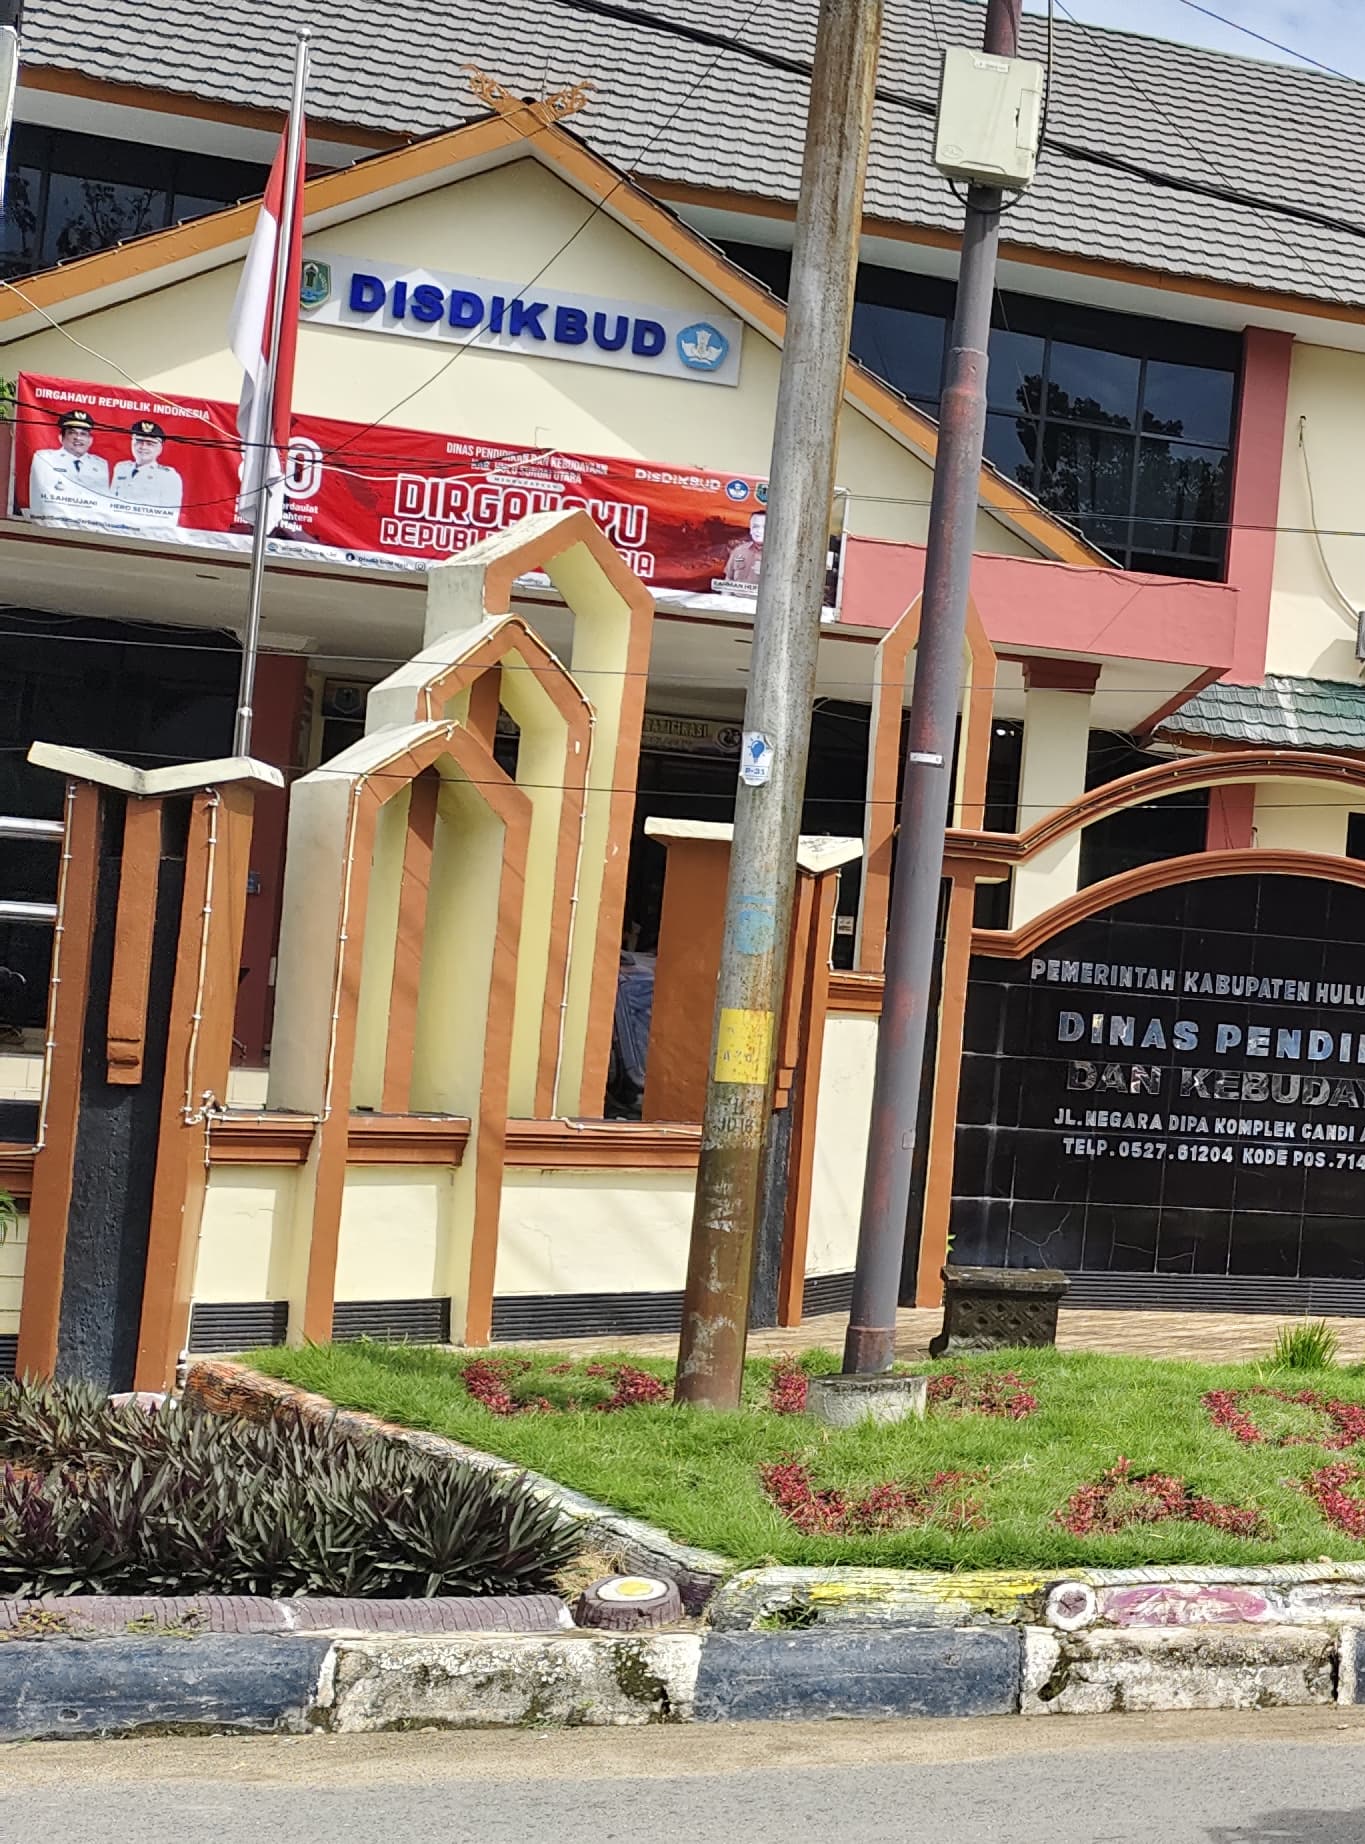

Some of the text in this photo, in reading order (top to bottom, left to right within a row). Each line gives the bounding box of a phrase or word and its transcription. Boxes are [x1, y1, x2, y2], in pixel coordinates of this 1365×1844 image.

[348, 272, 667, 357] DISDIKBUD
[35, 387, 210, 421] DIRGAHAYU REPUBLIK INDONESIA
[446, 442, 474, 457] DINAS
[1030, 958, 1175, 991] PEMERINTAH
[1183, 970, 1310, 1002] KABUPATEN
[1057, 1011, 1199, 1050] DINAS
[1066, 1060, 1162, 1095] DAN
[1168, 1114, 1209, 1133] DIPA
[1214, 1117, 1296, 1138] KOMPLEK
[1301, 1123, 1354, 1141] CANDI
[1242, 1147, 1288, 1166] KODE
